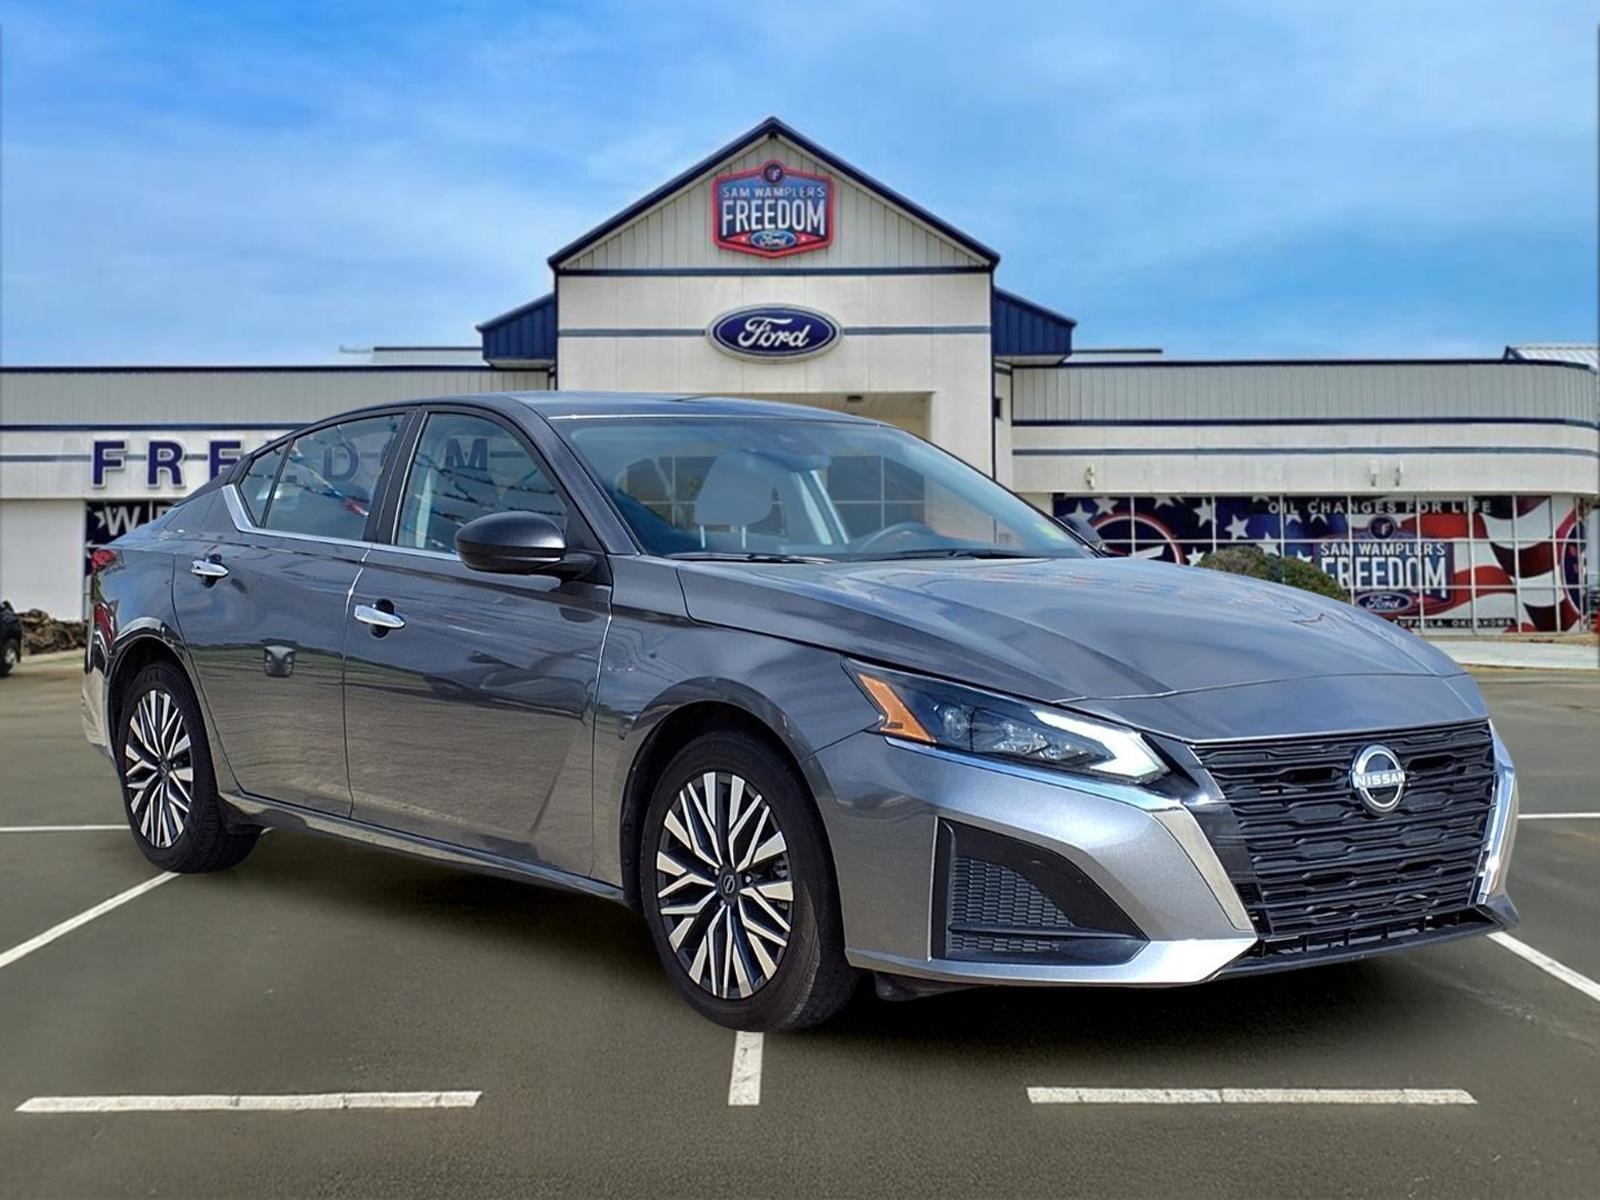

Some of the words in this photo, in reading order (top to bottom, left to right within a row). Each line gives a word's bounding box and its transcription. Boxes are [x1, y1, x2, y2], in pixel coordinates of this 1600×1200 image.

[722, 187, 750, 198] SAM
[722, 199, 825, 236] FREEDOM
[760, 232, 788, 247] Ford
[737, 316, 811, 347] Ford
[1268, 501, 1298, 514] OIL
[1307, 501, 1397, 514] CHANGES
[1406, 501, 1442, 513] FOR
[1451, 501, 1491, 513] LIFE
[1365, 595, 1400, 609] Ford
[1354, 772, 1405, 787] NISSAN
